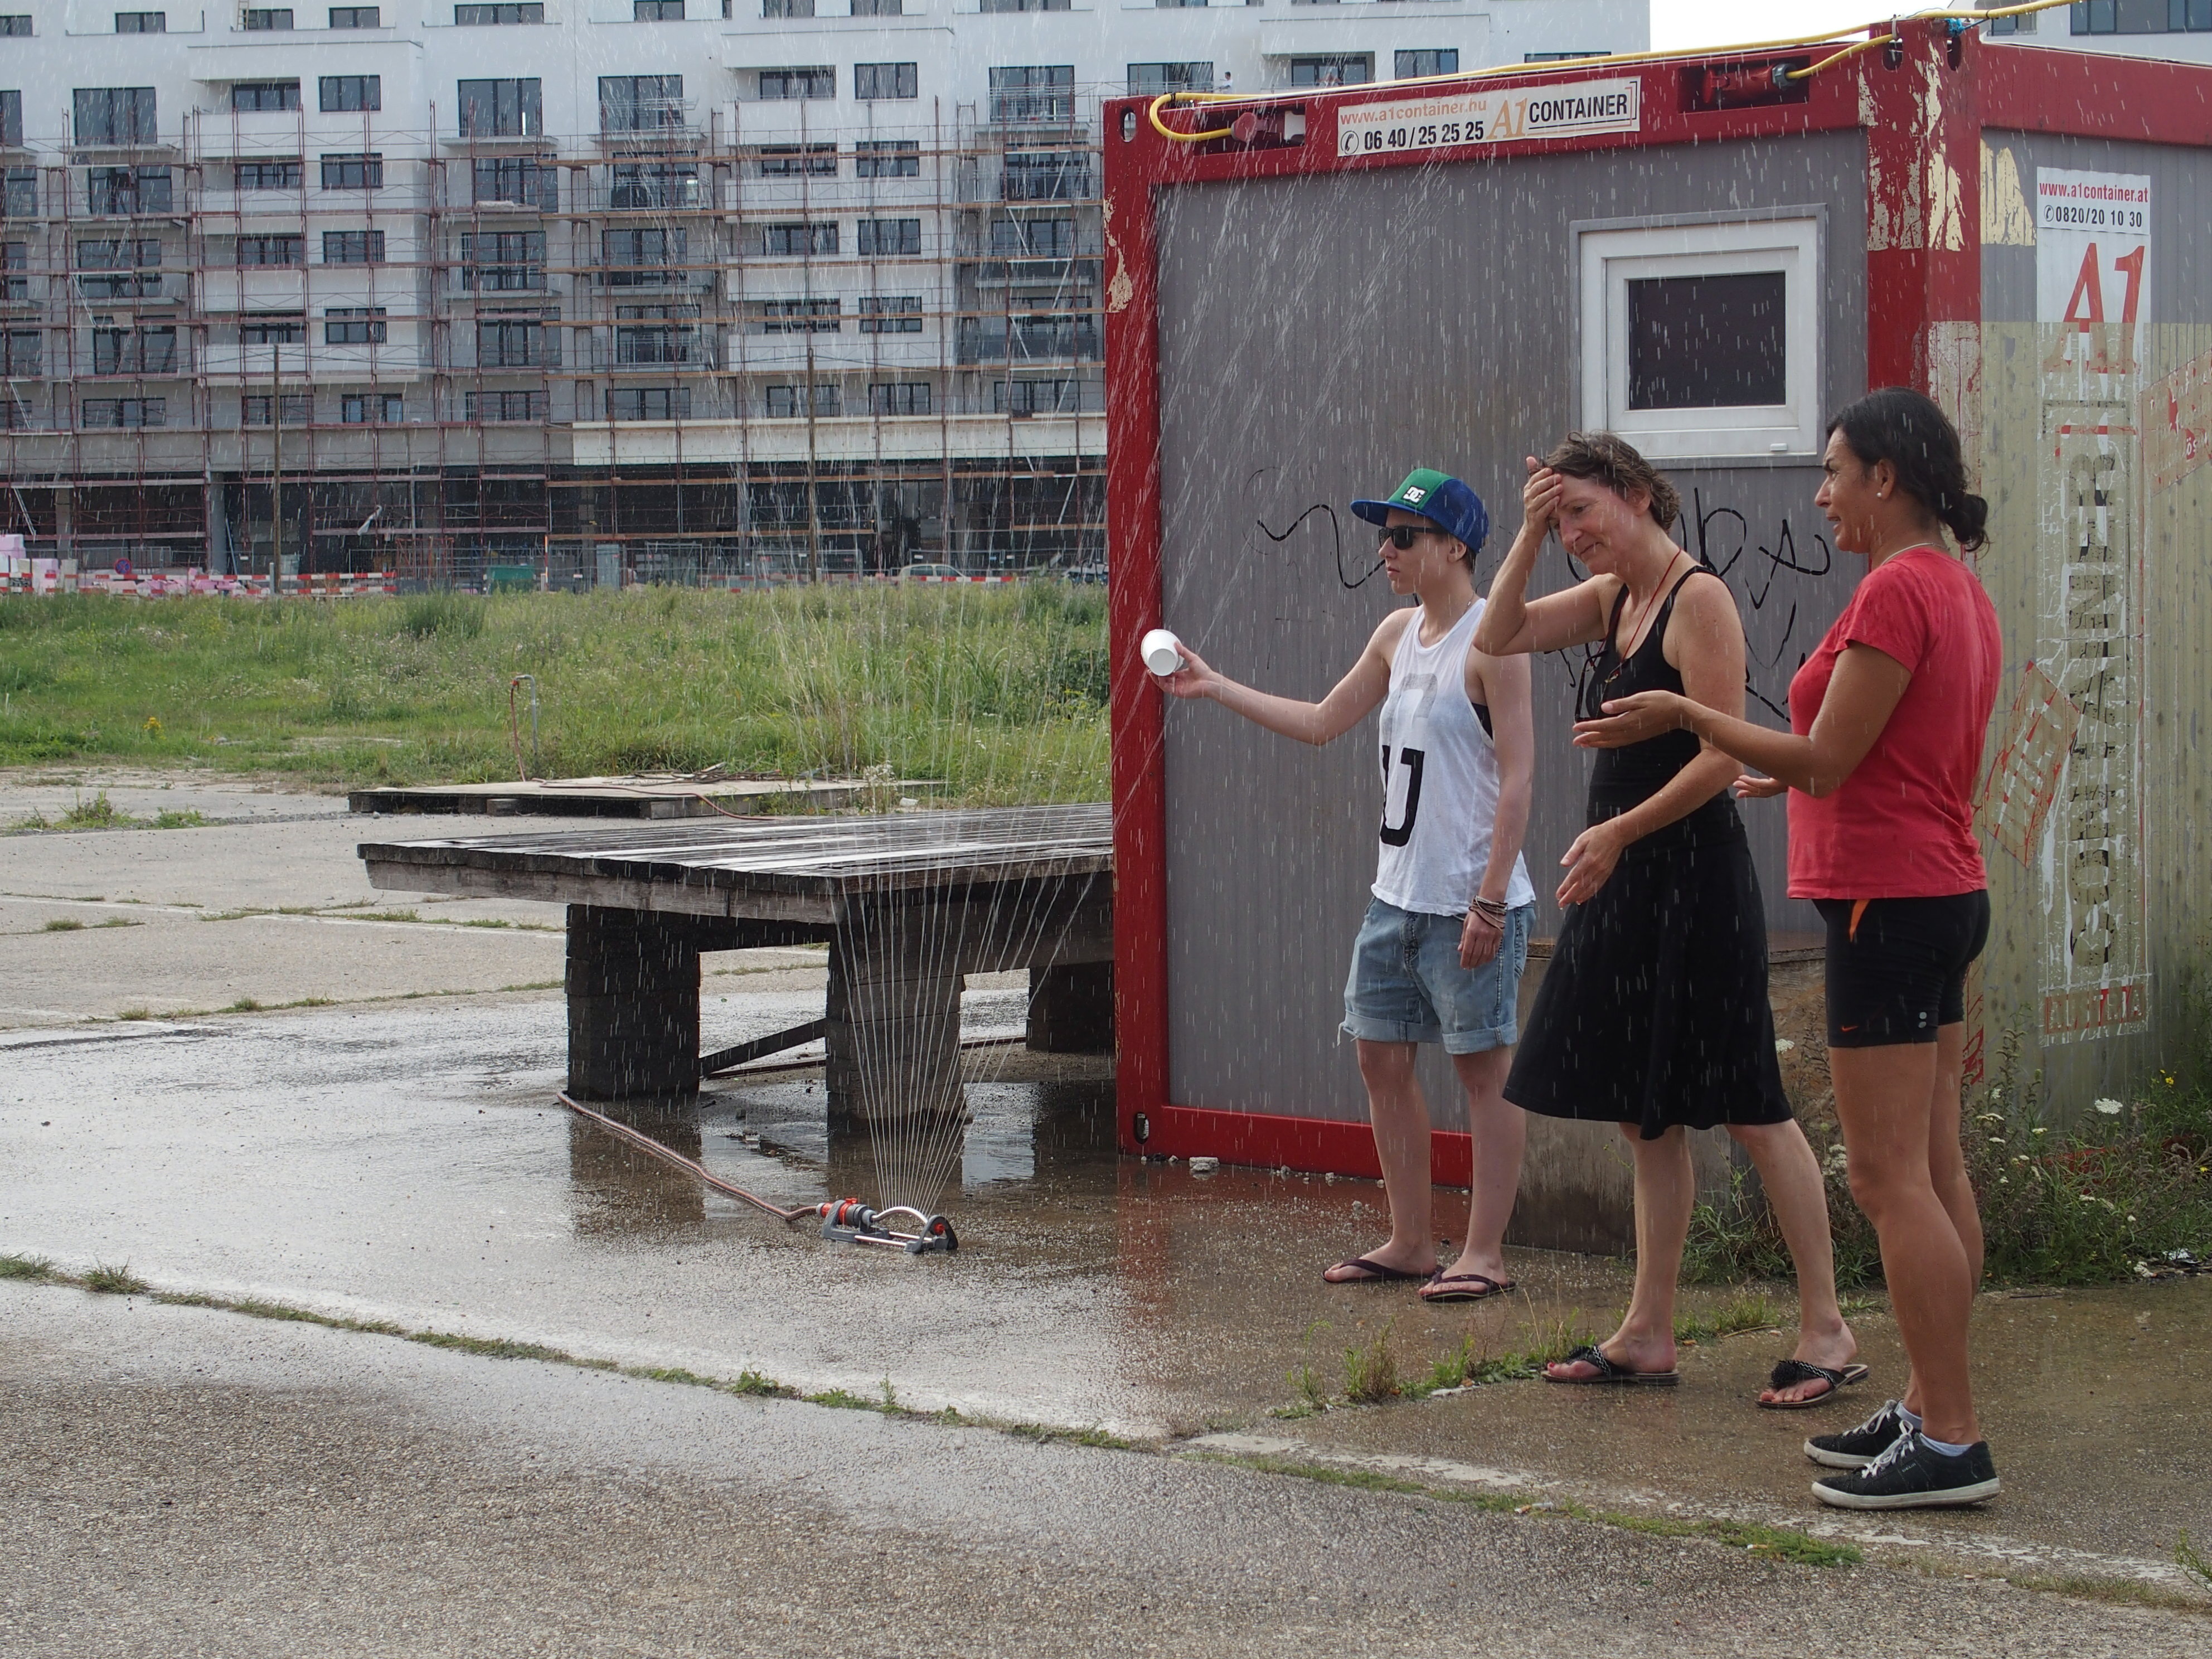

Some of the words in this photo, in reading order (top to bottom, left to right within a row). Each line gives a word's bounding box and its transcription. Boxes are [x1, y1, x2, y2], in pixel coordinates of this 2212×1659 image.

[1340, 98, 1487, 125] www.a1container.hu
[1487, 98, 1529, 139] A1
[1529, 94, 1627, 123] CONTAINER
[1364, 130, 1382, 151] 06
[1442, 123, 1459, 143] 25
[1466, 121, 1484, 140] 25
[2039, 181, 2148, 202] www.a1container.at
[2056, 206, 2104, 225] 0820/20
[2111, 210, 2124, 226] 10
[2129, 211, 2142, 227] 30
[2043, 242, 2145, 374] A1
[2069, 454, 2117, 966] CONTAINER
